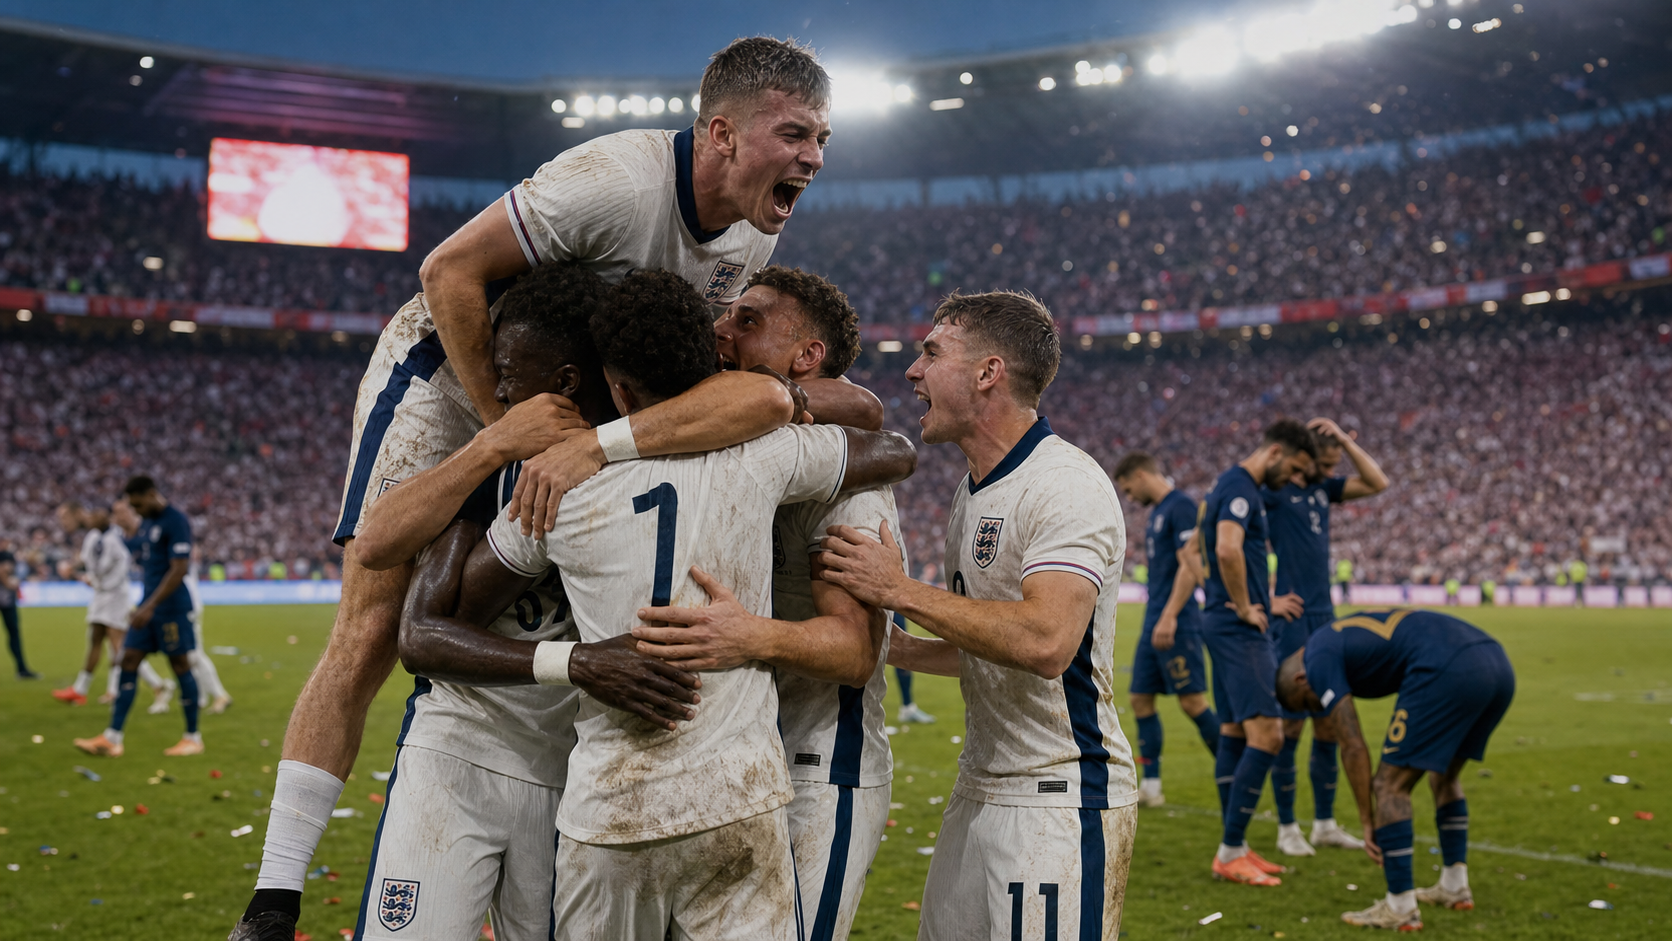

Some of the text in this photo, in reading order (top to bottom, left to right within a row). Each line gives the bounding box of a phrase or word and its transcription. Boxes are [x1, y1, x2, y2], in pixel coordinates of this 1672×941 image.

[632, 482, 678, 627] 1
[1388, 708, 1408, 744] 6
[1007, 882, 1060, 941] 11
